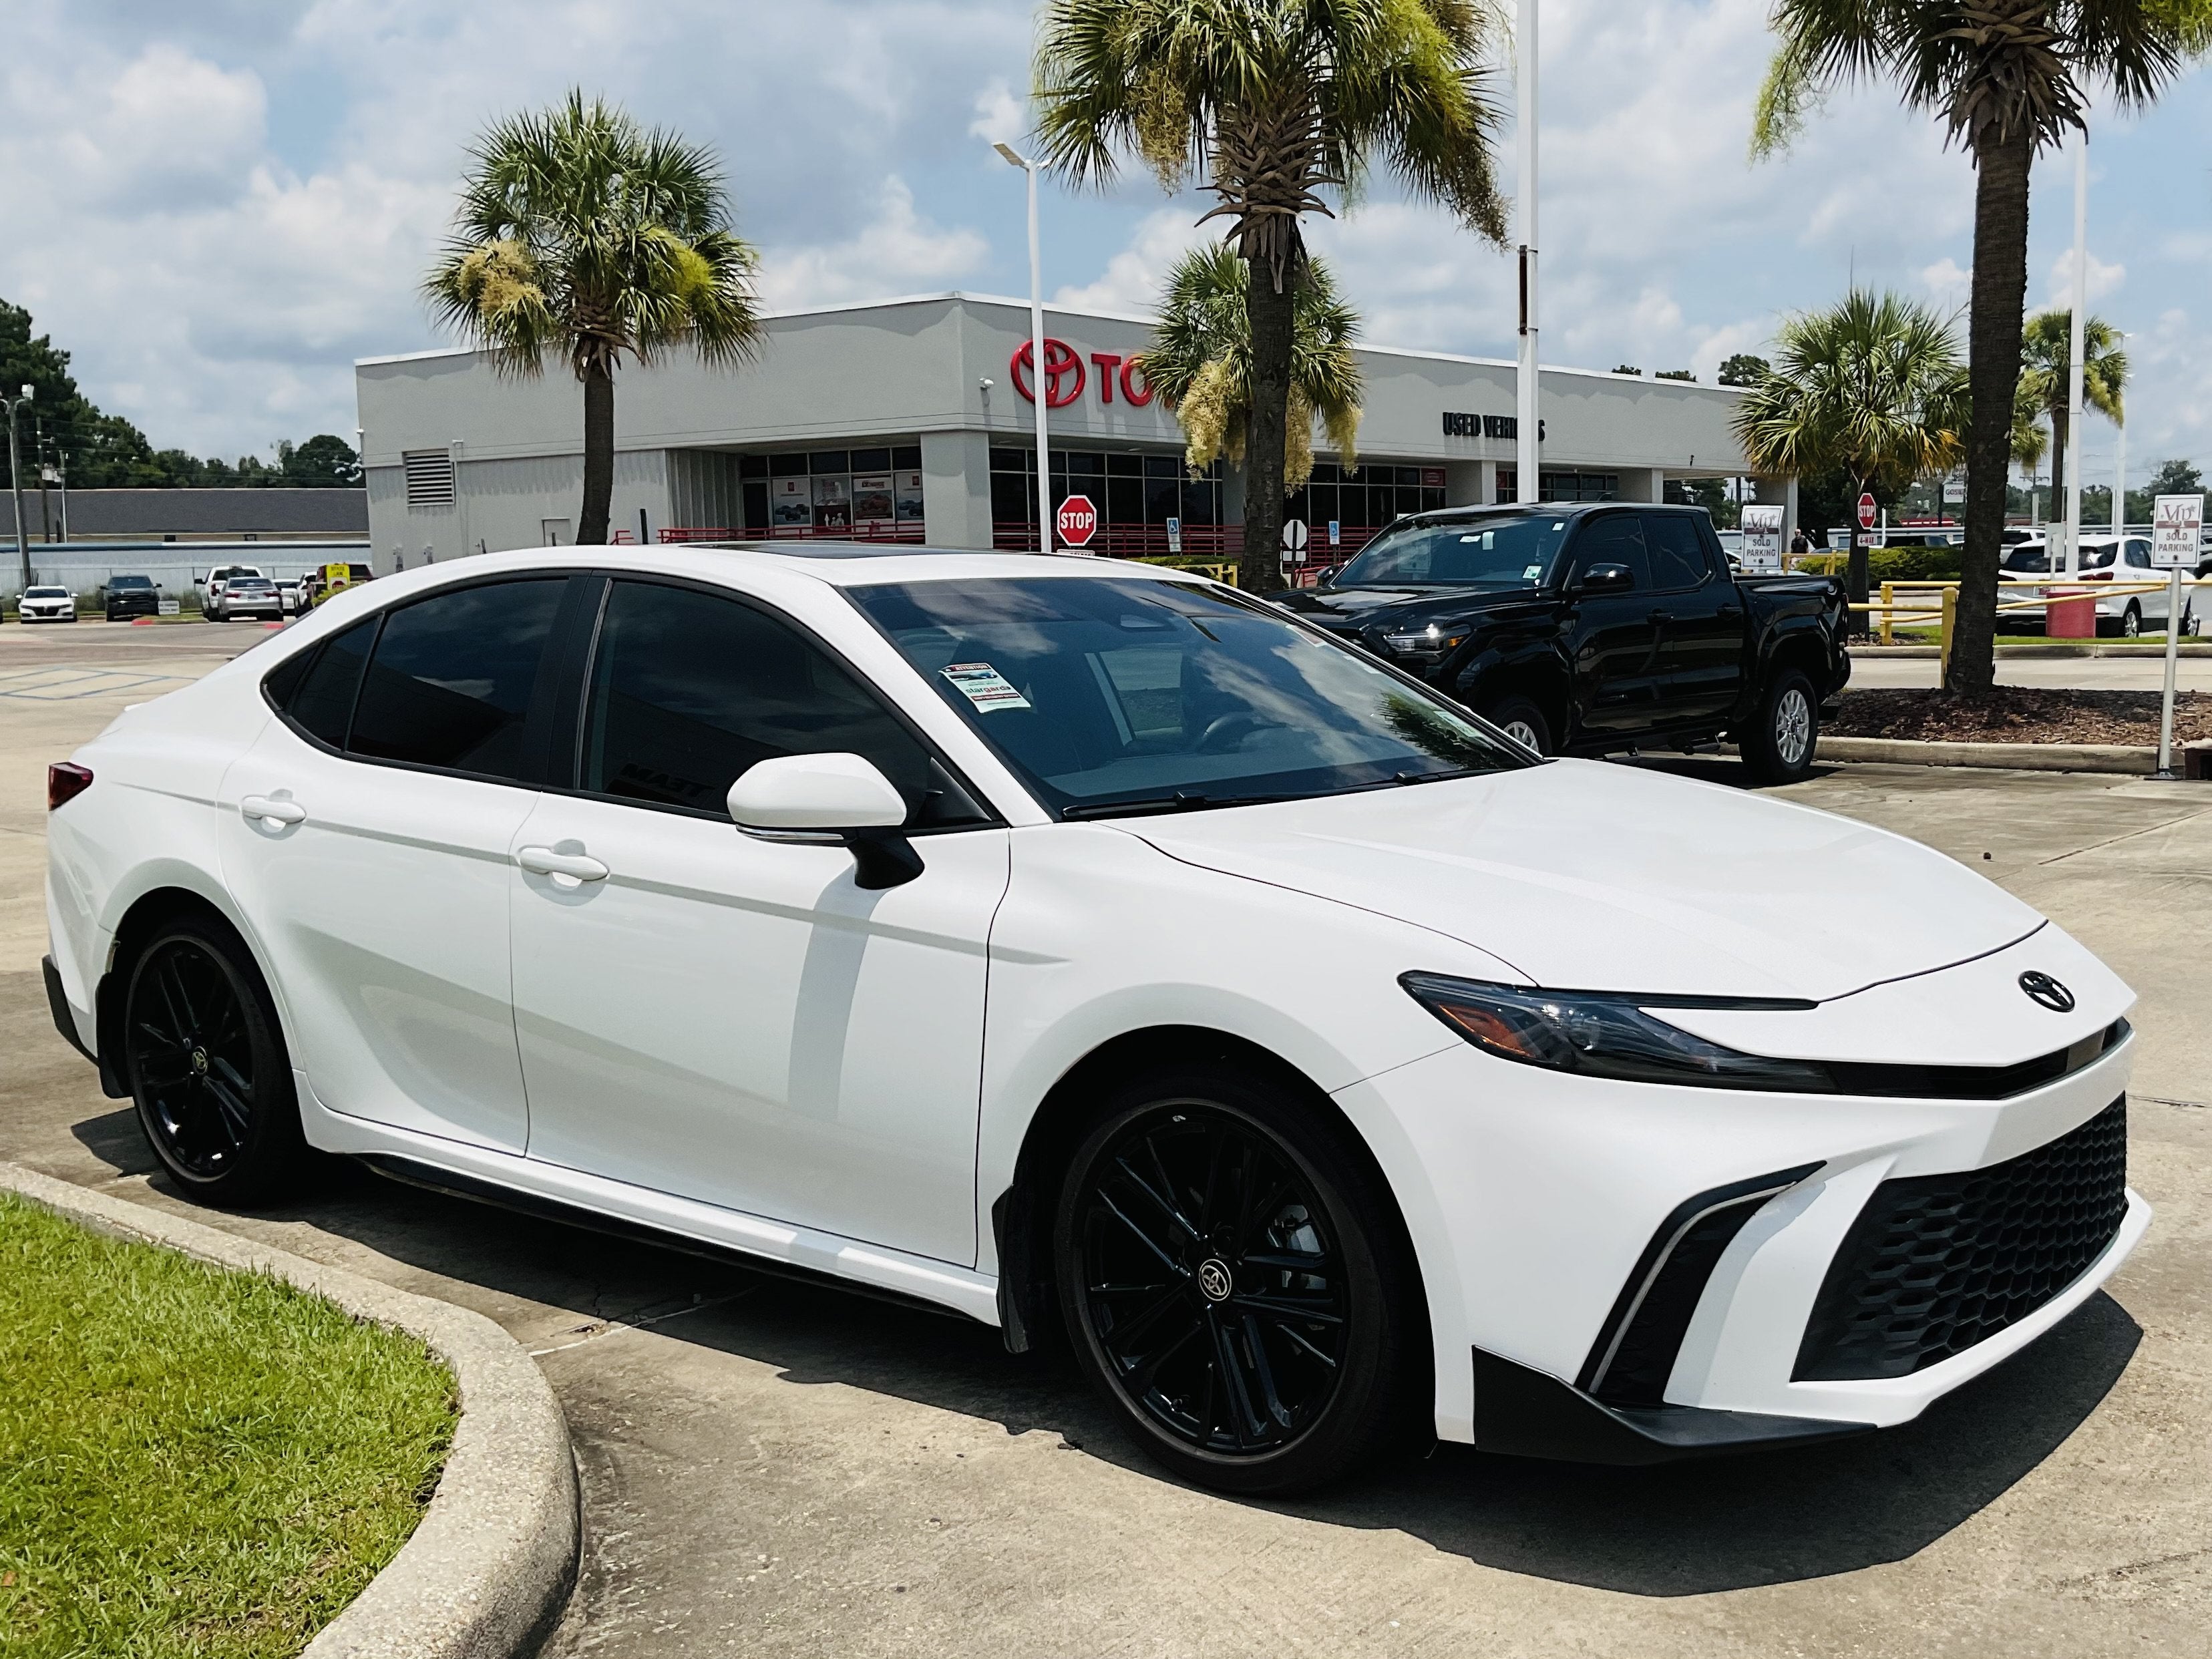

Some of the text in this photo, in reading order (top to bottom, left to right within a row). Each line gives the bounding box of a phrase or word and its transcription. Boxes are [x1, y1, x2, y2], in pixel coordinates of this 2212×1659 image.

[1443, 411, 1545, 441] USED VEHIS
[1859, 505, 1875, 518] STOP
[1061, 512, 1093, 529] STOP
[2166, 532, 2188, 541] SOLD
[1753, 538, 1771, 546] SOLD
[2158, 543, 2193, 552] PARKING
[1746, 549, 1776, 557] PARKING
